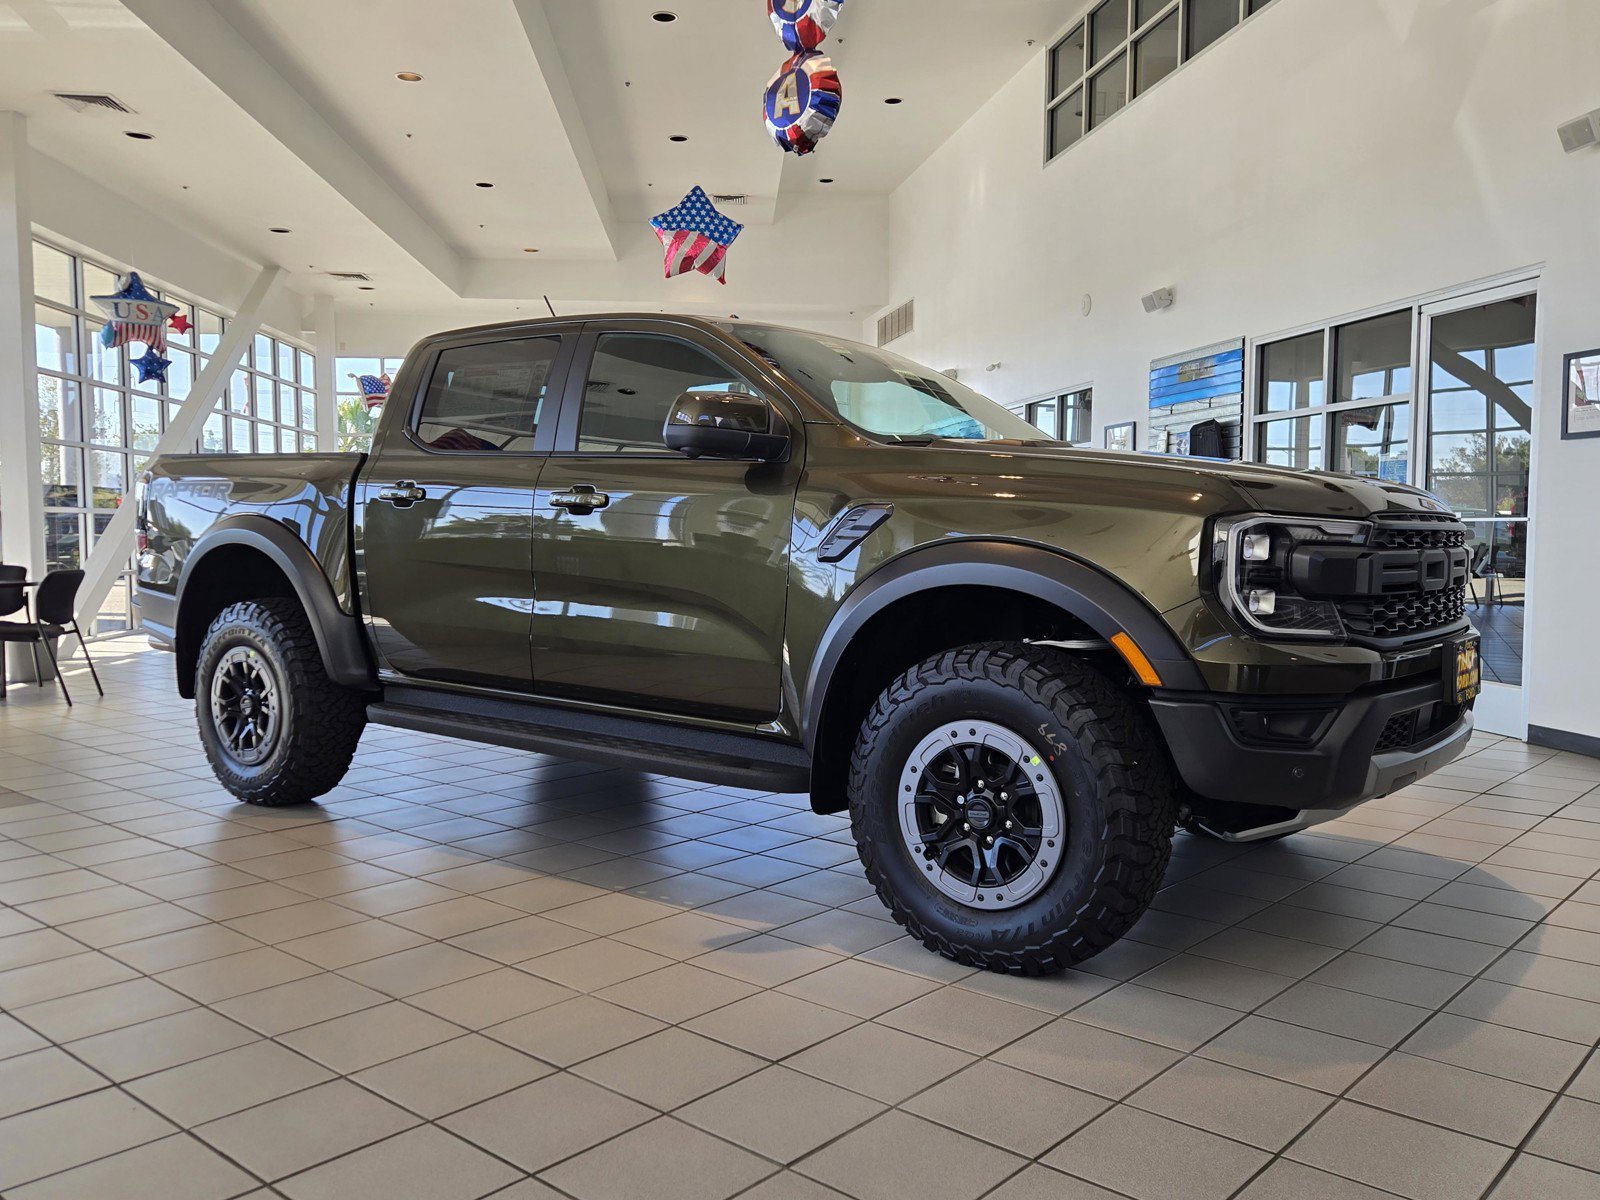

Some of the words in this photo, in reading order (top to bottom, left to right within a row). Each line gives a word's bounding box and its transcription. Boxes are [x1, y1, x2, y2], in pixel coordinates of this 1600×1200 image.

[774, 72, 800, 119] A
[152, 481, 234, 501] RAPTOR
[1371, 548, 1474, 594] FOR
